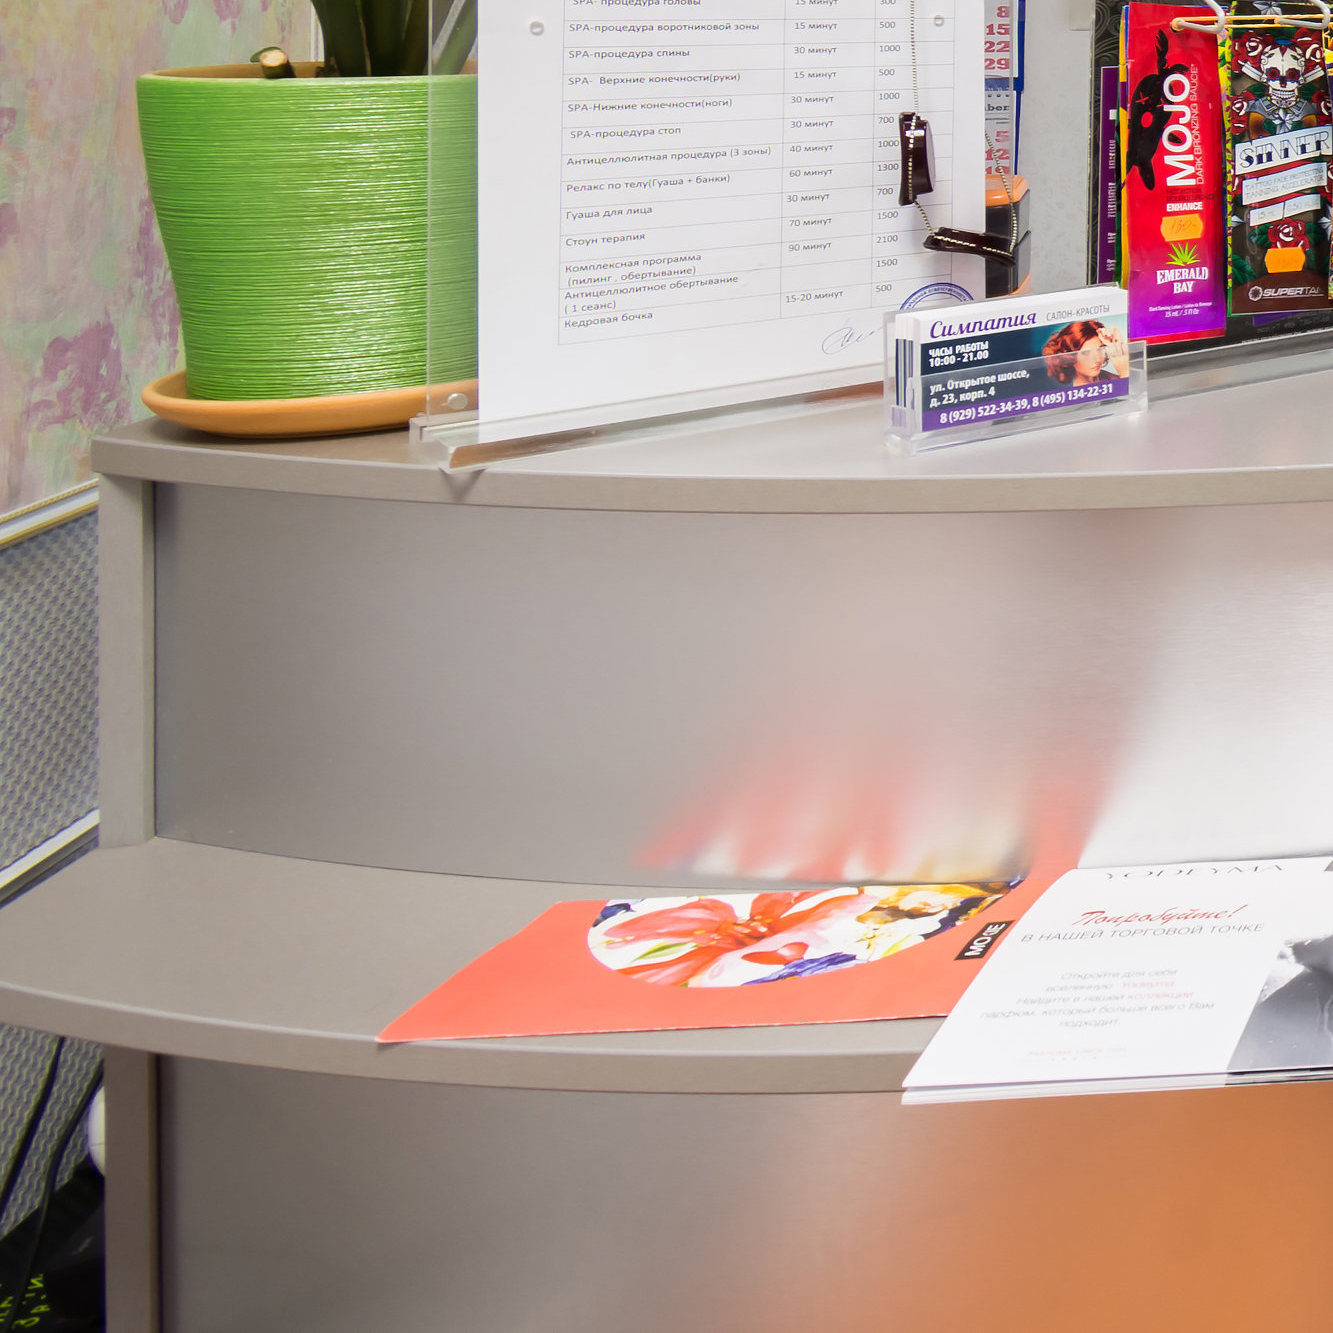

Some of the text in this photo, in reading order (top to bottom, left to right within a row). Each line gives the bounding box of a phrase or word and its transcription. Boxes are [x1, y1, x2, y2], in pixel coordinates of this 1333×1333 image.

[984, 59, 1010, 70] 29
[1162, 73, 1197, 187] MOJO
[1190, 103, 1202, 155] BRONZING
[567, 150, 727, 166] Антицеллюлитная процедура
[1240, 131, 1330, 168] SINNER
[1195, 156, 1205, 185] DARK
[1166, 201, 1204, 212] ENHANCE
[876, 235, 898, 244] 2100
[1156, 267, 1209, 284] EMERALD
[1173, 281, 1194, 294] BAY
[786, 294, 812, 303] 15-20
[929, 304, 1110, 339] Симпатия САЛОН-КРАСОТЫ
[928, 340, 989, 358] ЧАСЫ РАБОТЫ
[929, 350, 989, 367] 10:00 21.00
[929, 369, 1030, 395] ул. Открытое шоссе,
[942, 390, 987, 406] 23, корп.
[949, 383, 1113, 424] (929) 522-34-39, (495) 134-22-31
[1071, 904, 1249, 927] Попробуйте!
[1021, 923, 1265, 942] В НАШЕЙ ТОРГОВОЙ ТОЧКЕ
